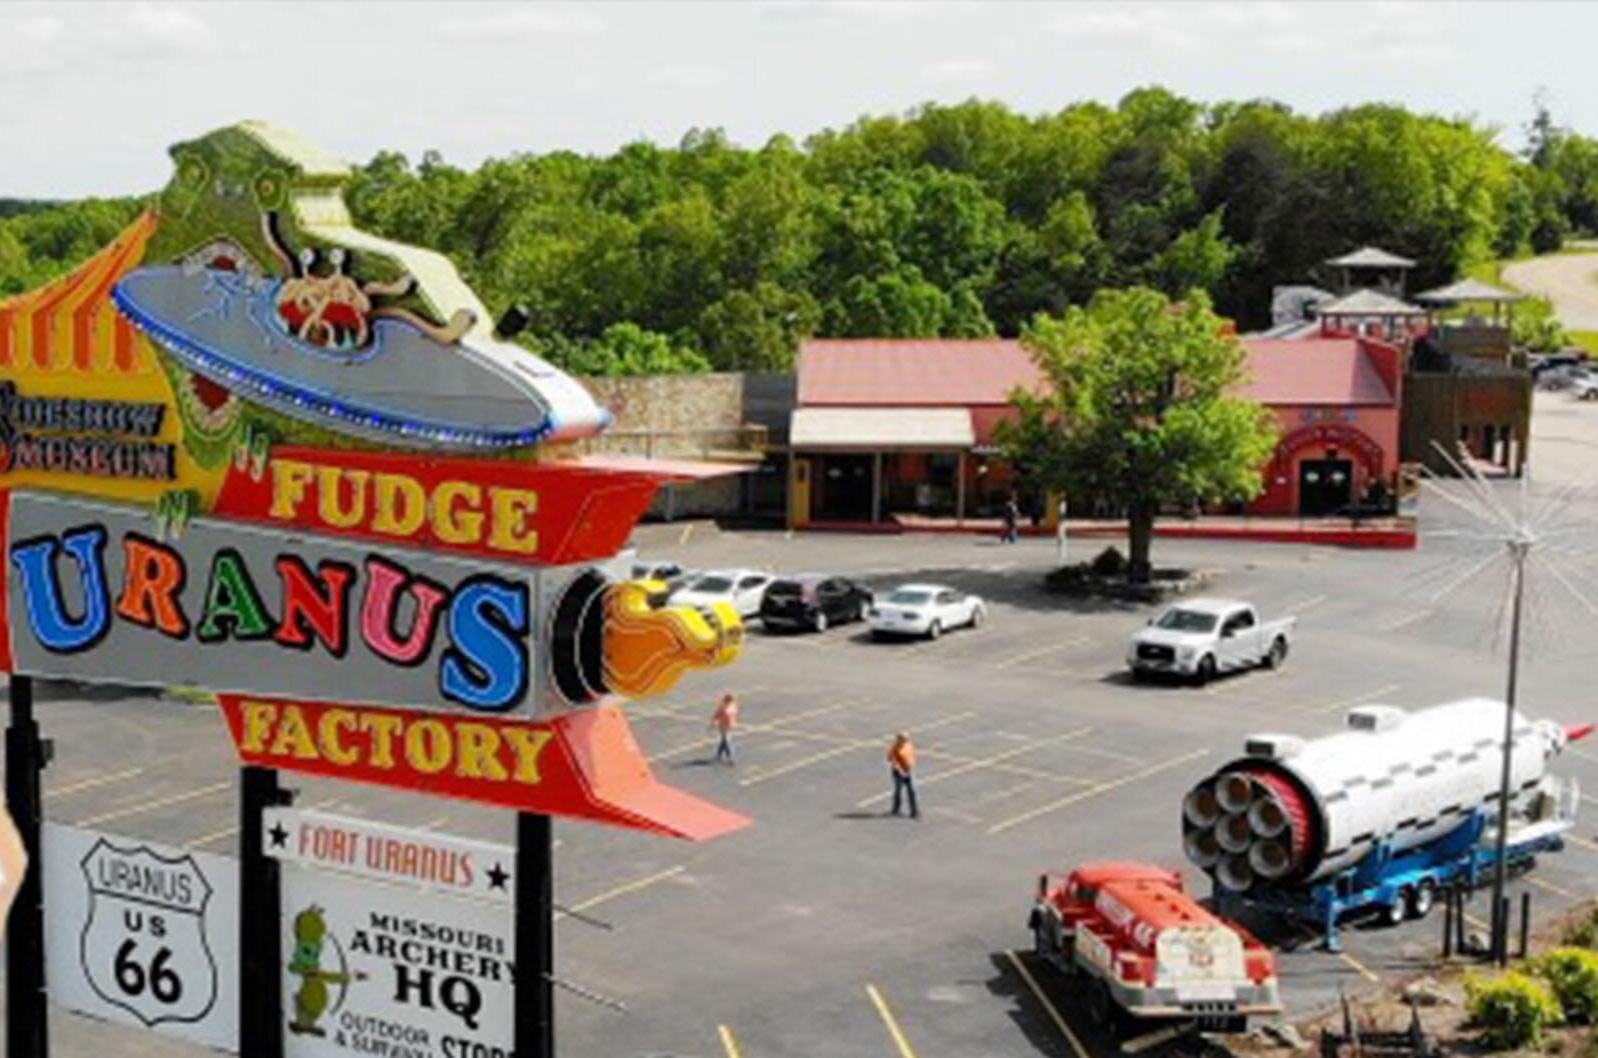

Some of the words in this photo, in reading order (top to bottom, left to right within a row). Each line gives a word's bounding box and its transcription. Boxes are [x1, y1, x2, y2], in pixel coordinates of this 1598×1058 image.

[14, 433, 177, 480] MUSEUM
[270, 460, 540, 556] FUDGE
[10, 525, 532, 712] URANUS
[239, 699, 554, 787] FACTORY
[98, 857, 193, 905] URANUS
[298, 822, 360, 866] FORT
[365, 836, 475, 888] URANUS
[369, 911, 505, 955] MISSOURI
[113, 937, 183, 1005] 66
[394, 963, 482, 1031] HQ
[340, 1010, 431, 1046] OUTDOOR
